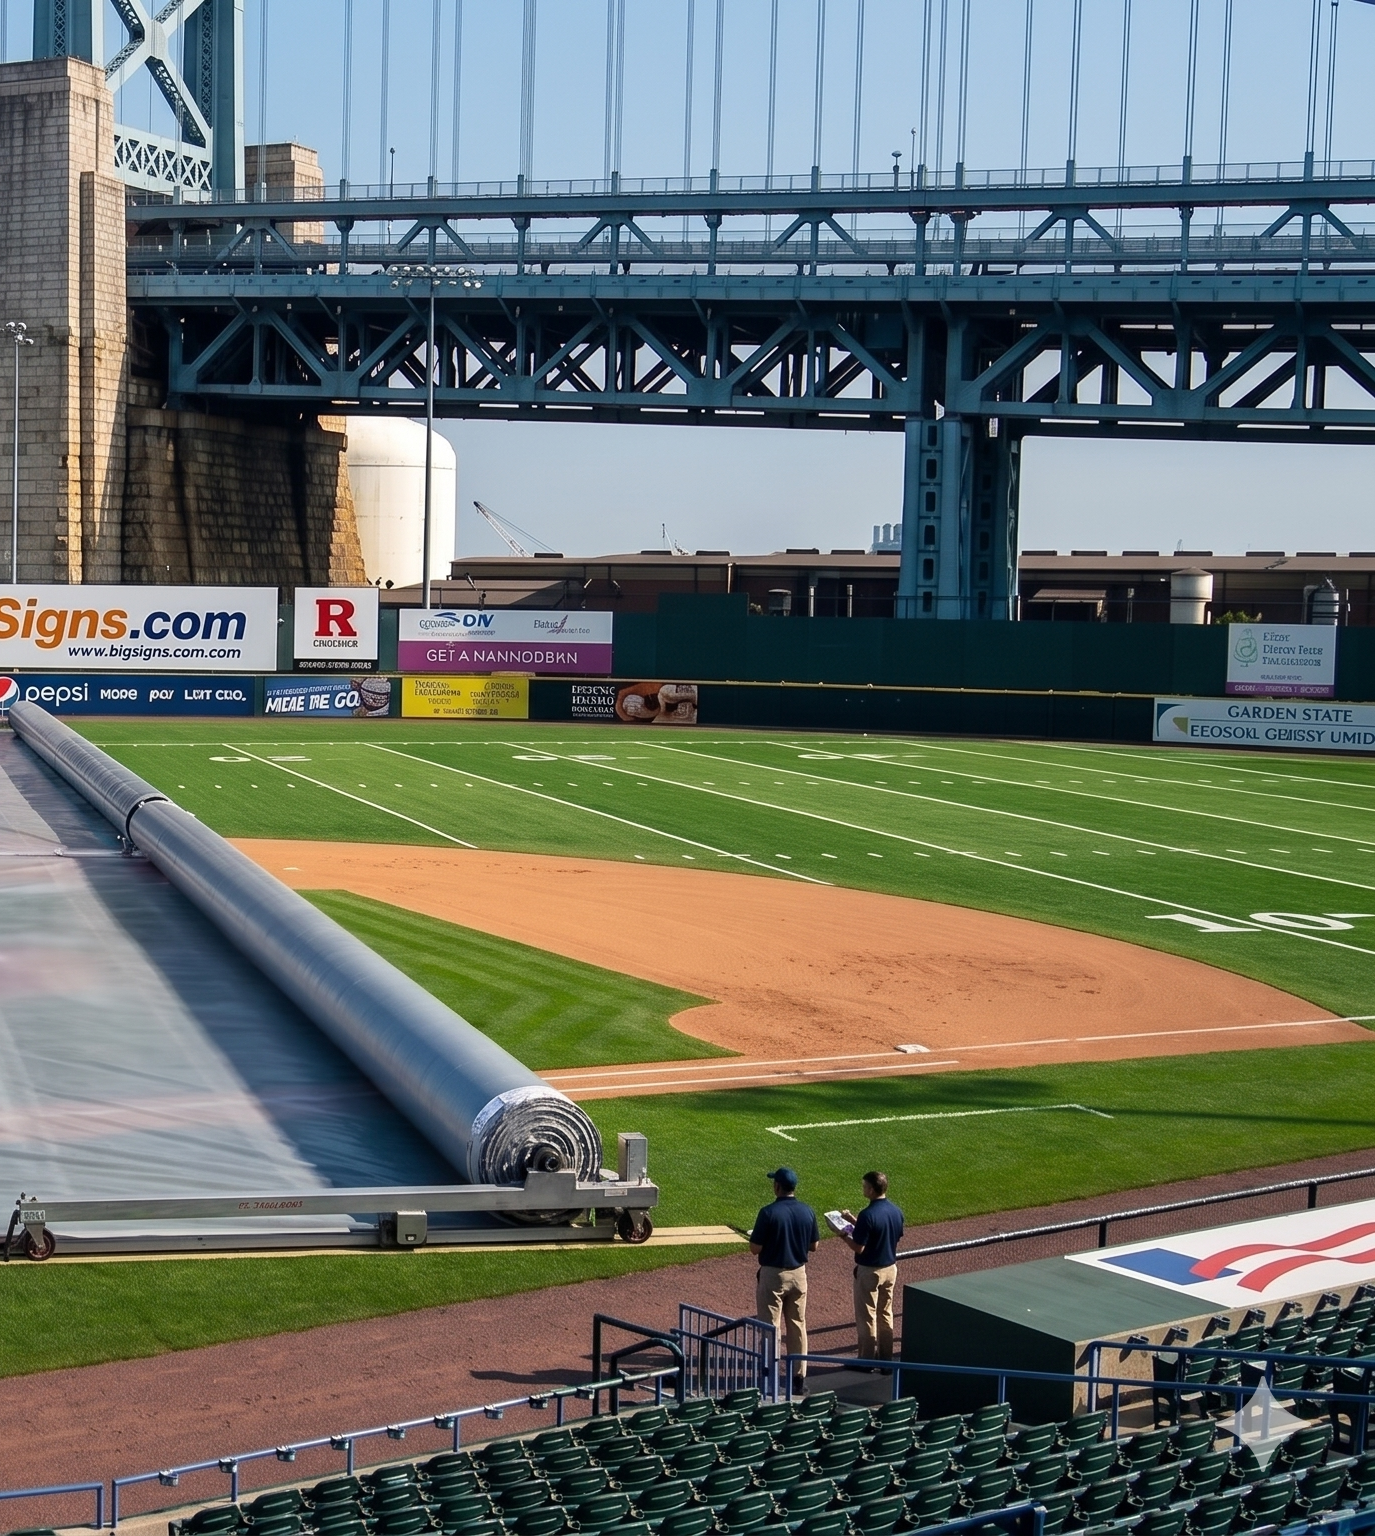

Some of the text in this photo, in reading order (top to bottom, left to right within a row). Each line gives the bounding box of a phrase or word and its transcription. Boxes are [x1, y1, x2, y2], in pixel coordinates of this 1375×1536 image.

[314, 599, 357, 637] R
[68, 643, 241, 661] www.bigsigns.com.com
[426, 649, 455, 662] GET
[458, 650, 470, 662] A
[25, 682, 89, 707] pepsi
[1227, 705, 1353, 723] GARDEN STATE
